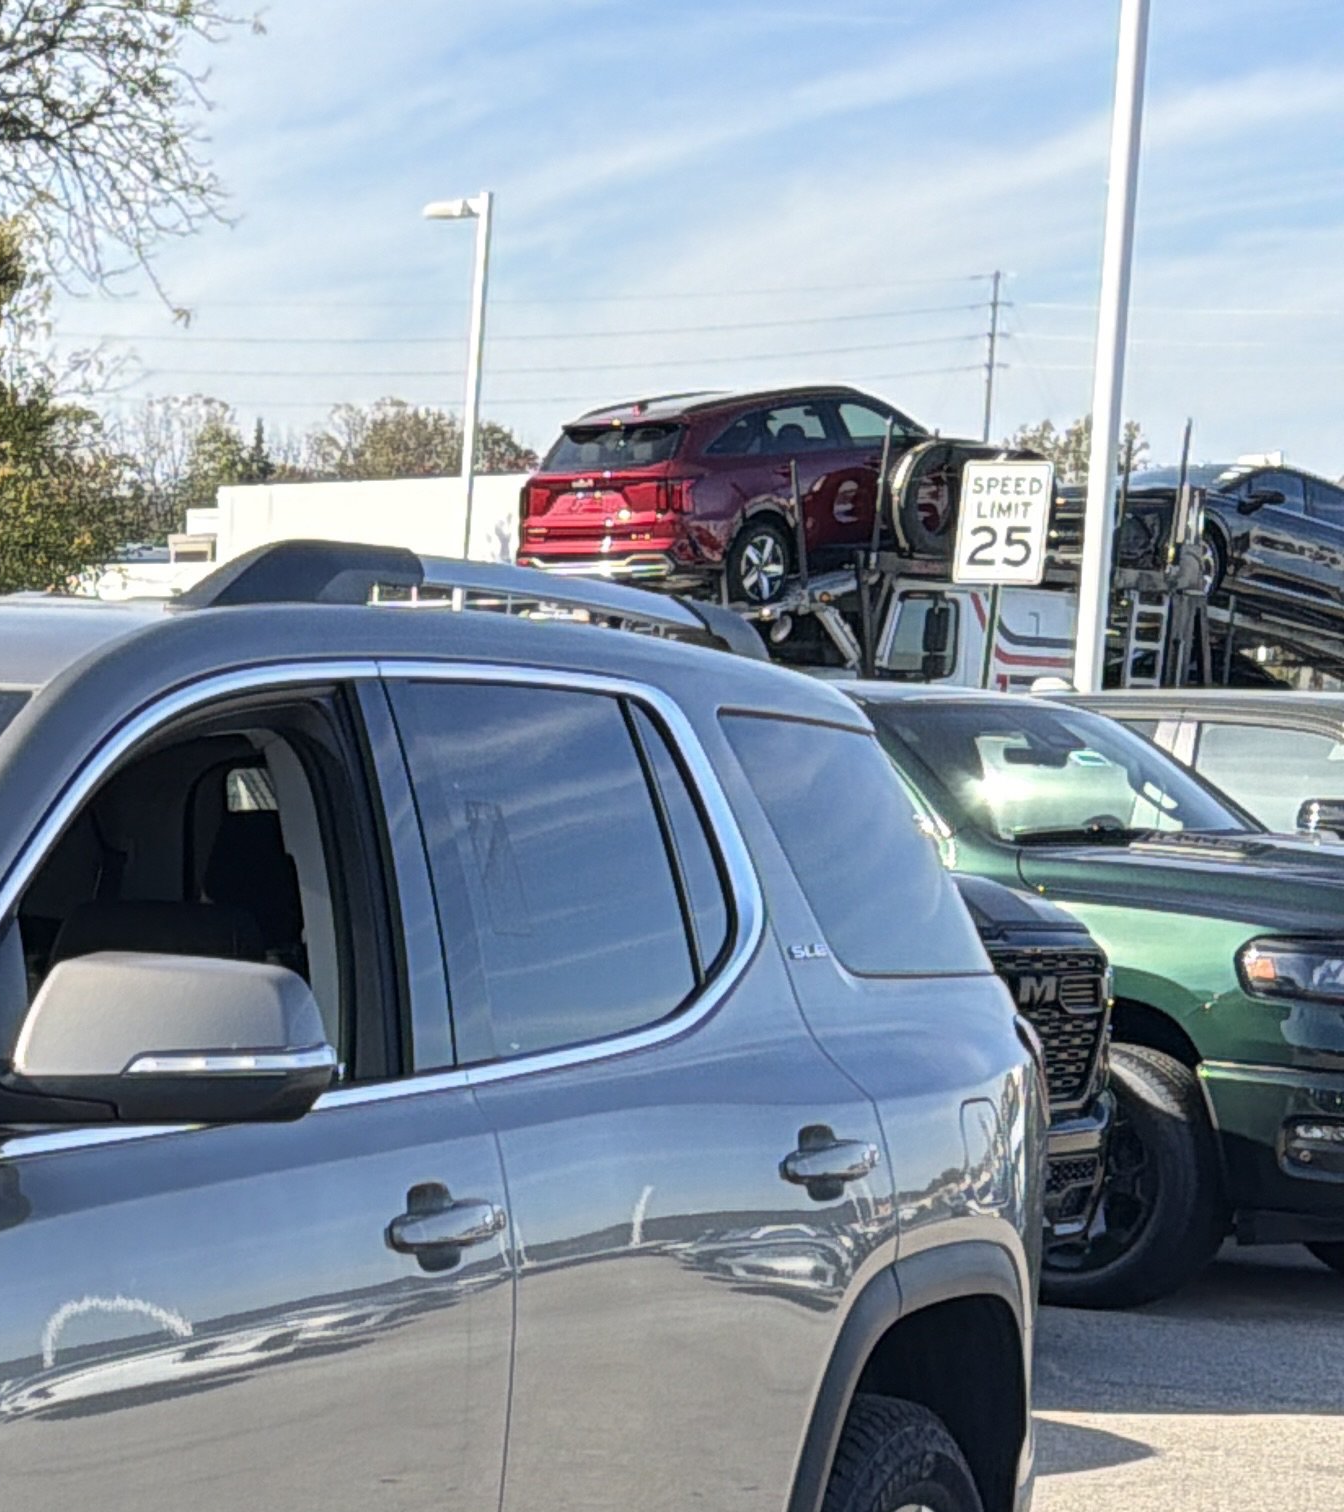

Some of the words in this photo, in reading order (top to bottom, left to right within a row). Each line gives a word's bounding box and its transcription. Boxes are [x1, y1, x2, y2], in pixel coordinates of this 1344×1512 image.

[971, 476, 1044, 495] SPEED
[976, 500, 1032, 519] LIMIT
[966, 525, 1032, 567] 25
